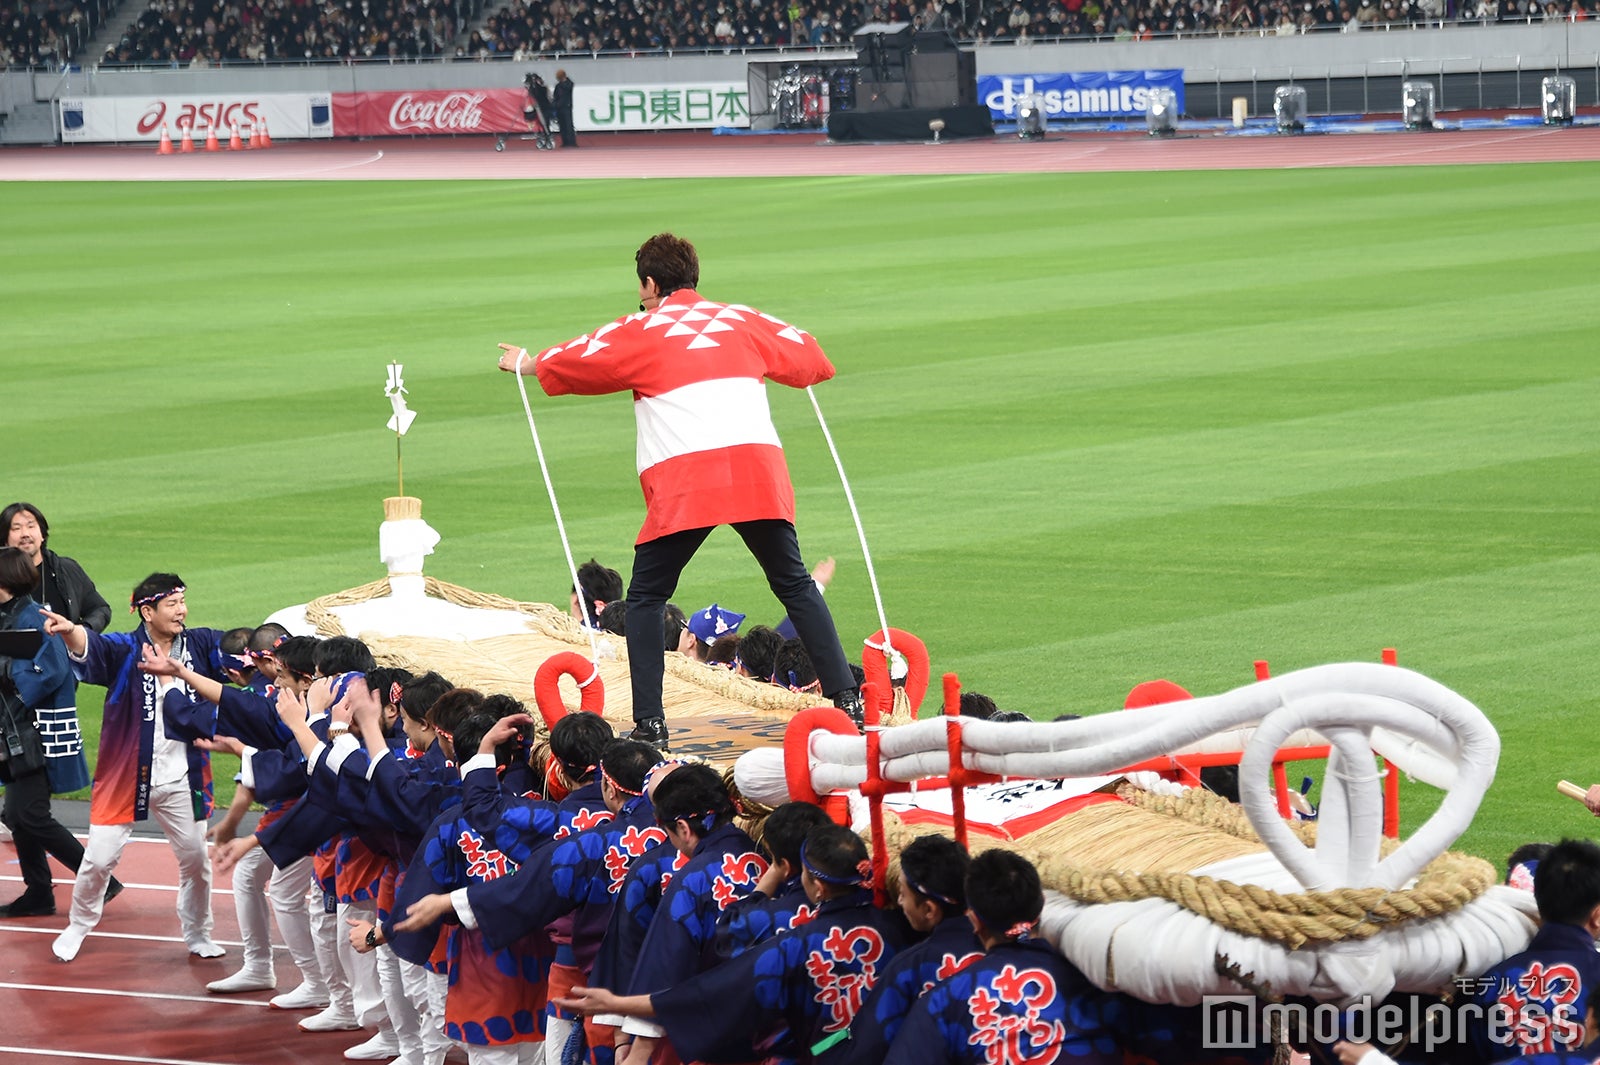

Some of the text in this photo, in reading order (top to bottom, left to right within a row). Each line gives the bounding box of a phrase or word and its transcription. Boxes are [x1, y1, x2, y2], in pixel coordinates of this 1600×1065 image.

[589, 87, 749, 125] JR東日本
[986, 77, 1172, 114] Hsamits
[175, 102, 259, 131] asics
